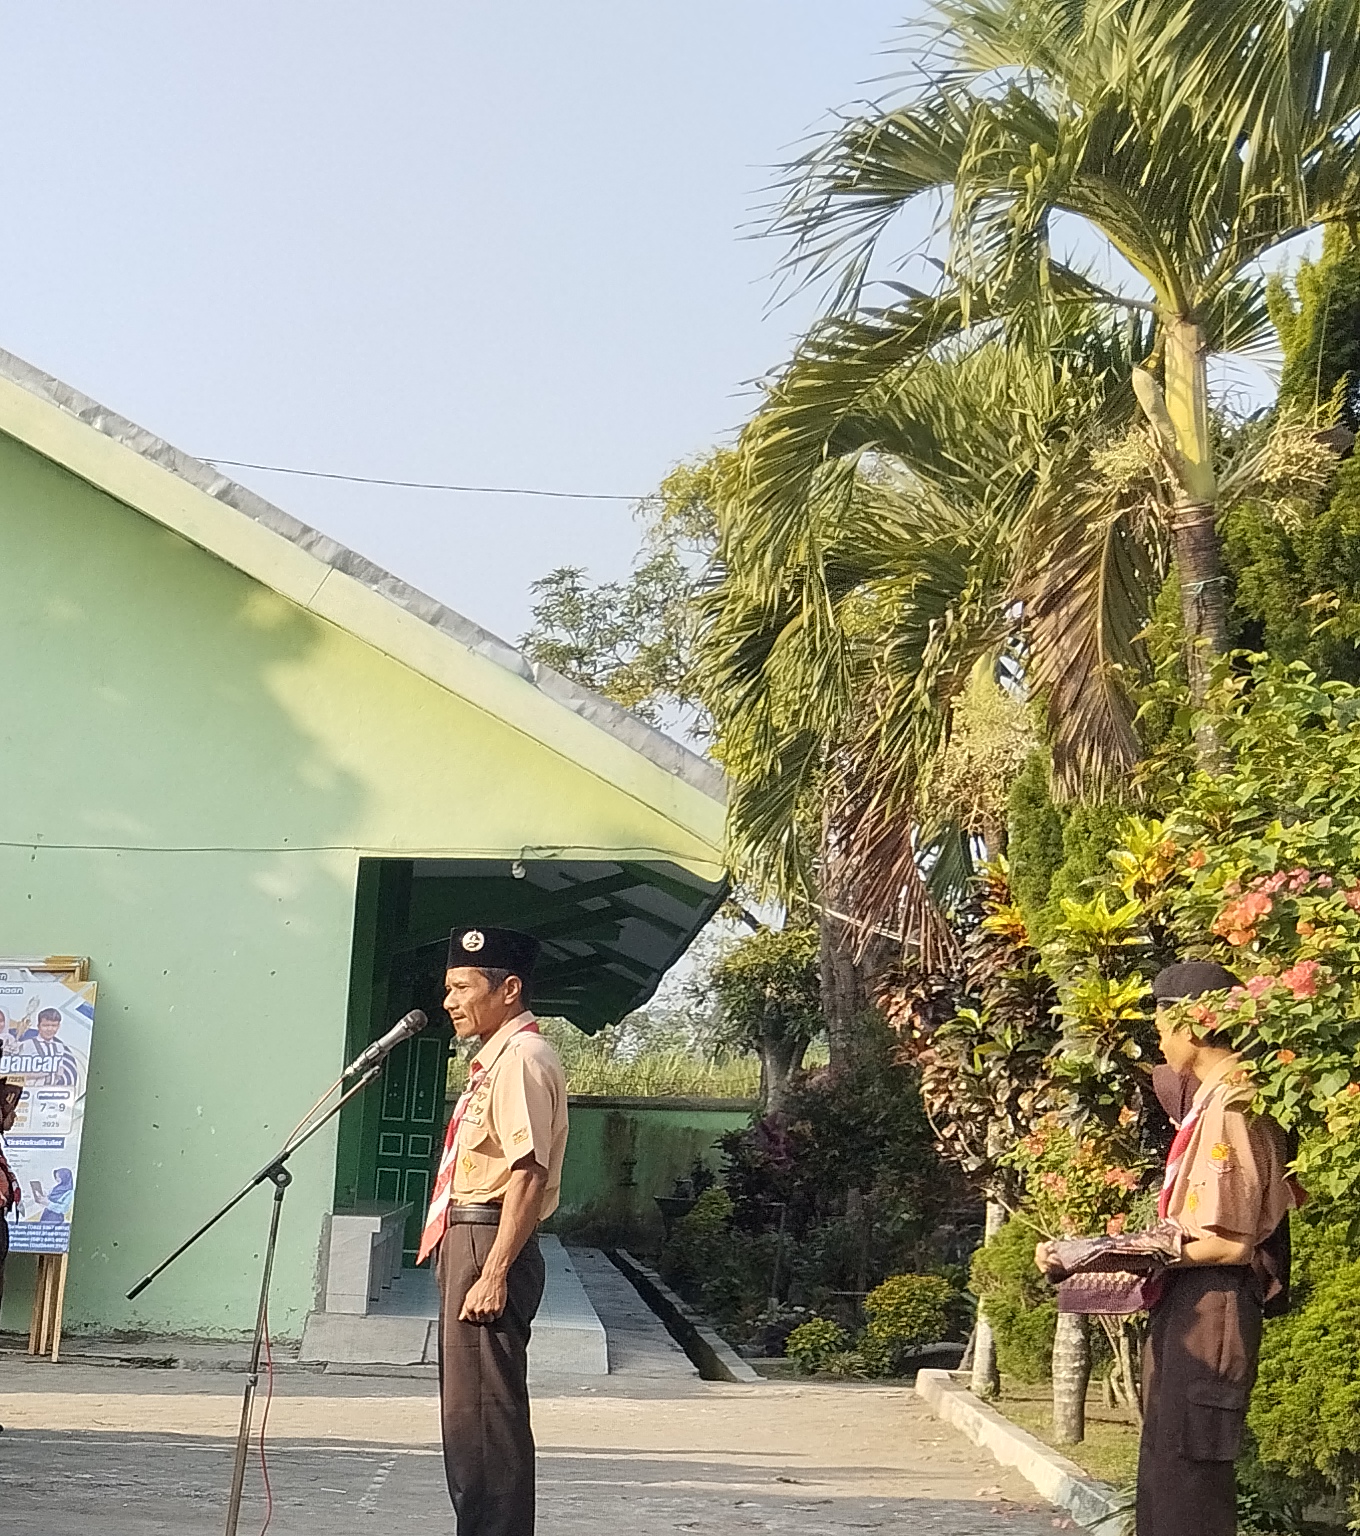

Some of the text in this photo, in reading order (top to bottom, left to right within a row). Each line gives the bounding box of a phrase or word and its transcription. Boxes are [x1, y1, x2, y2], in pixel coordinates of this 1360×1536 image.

[0, 1054, 63, 1073] gancar
[40, 1103, 47, 1112] 7
[59, 1103, 66, 1112] 9
